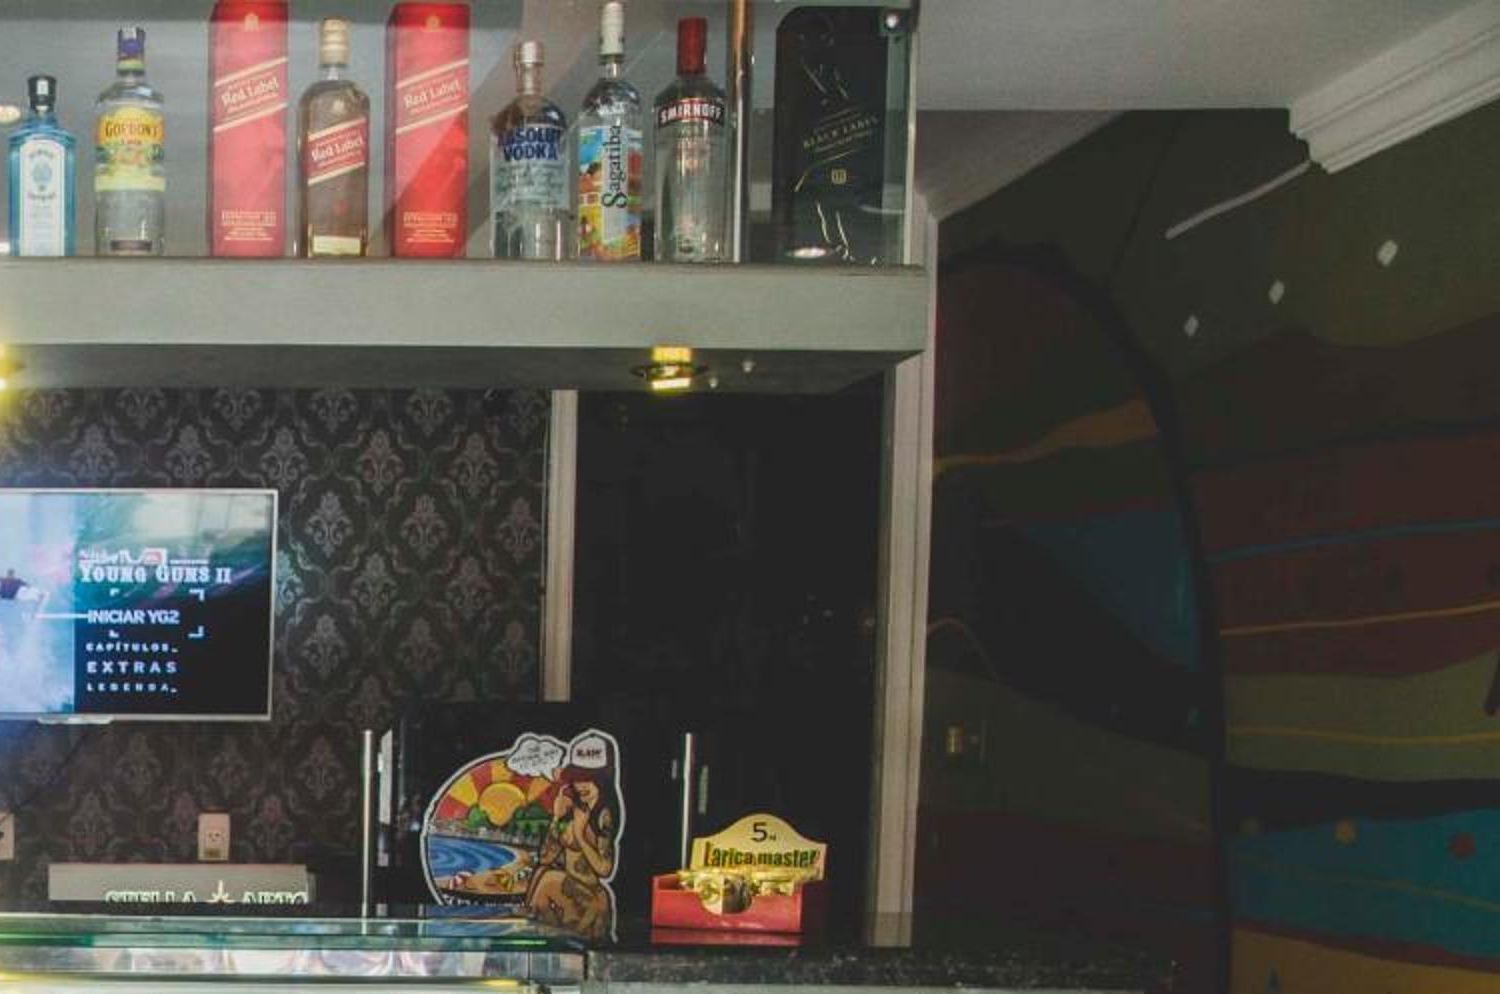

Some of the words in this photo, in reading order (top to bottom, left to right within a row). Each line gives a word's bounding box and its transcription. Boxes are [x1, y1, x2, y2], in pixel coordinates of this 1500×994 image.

[660, 103, 722, 123] SMIRNOFF
[503, 142, 559, 162] VODKA
[601, 125, 628, 208] Sagatiba
[87, 610, 145, 624] INICIAR
[148, 610, 180, 624] YG2
[86, 661, 177, 674] EXTRAS
[757, 849, 816, 867] master
